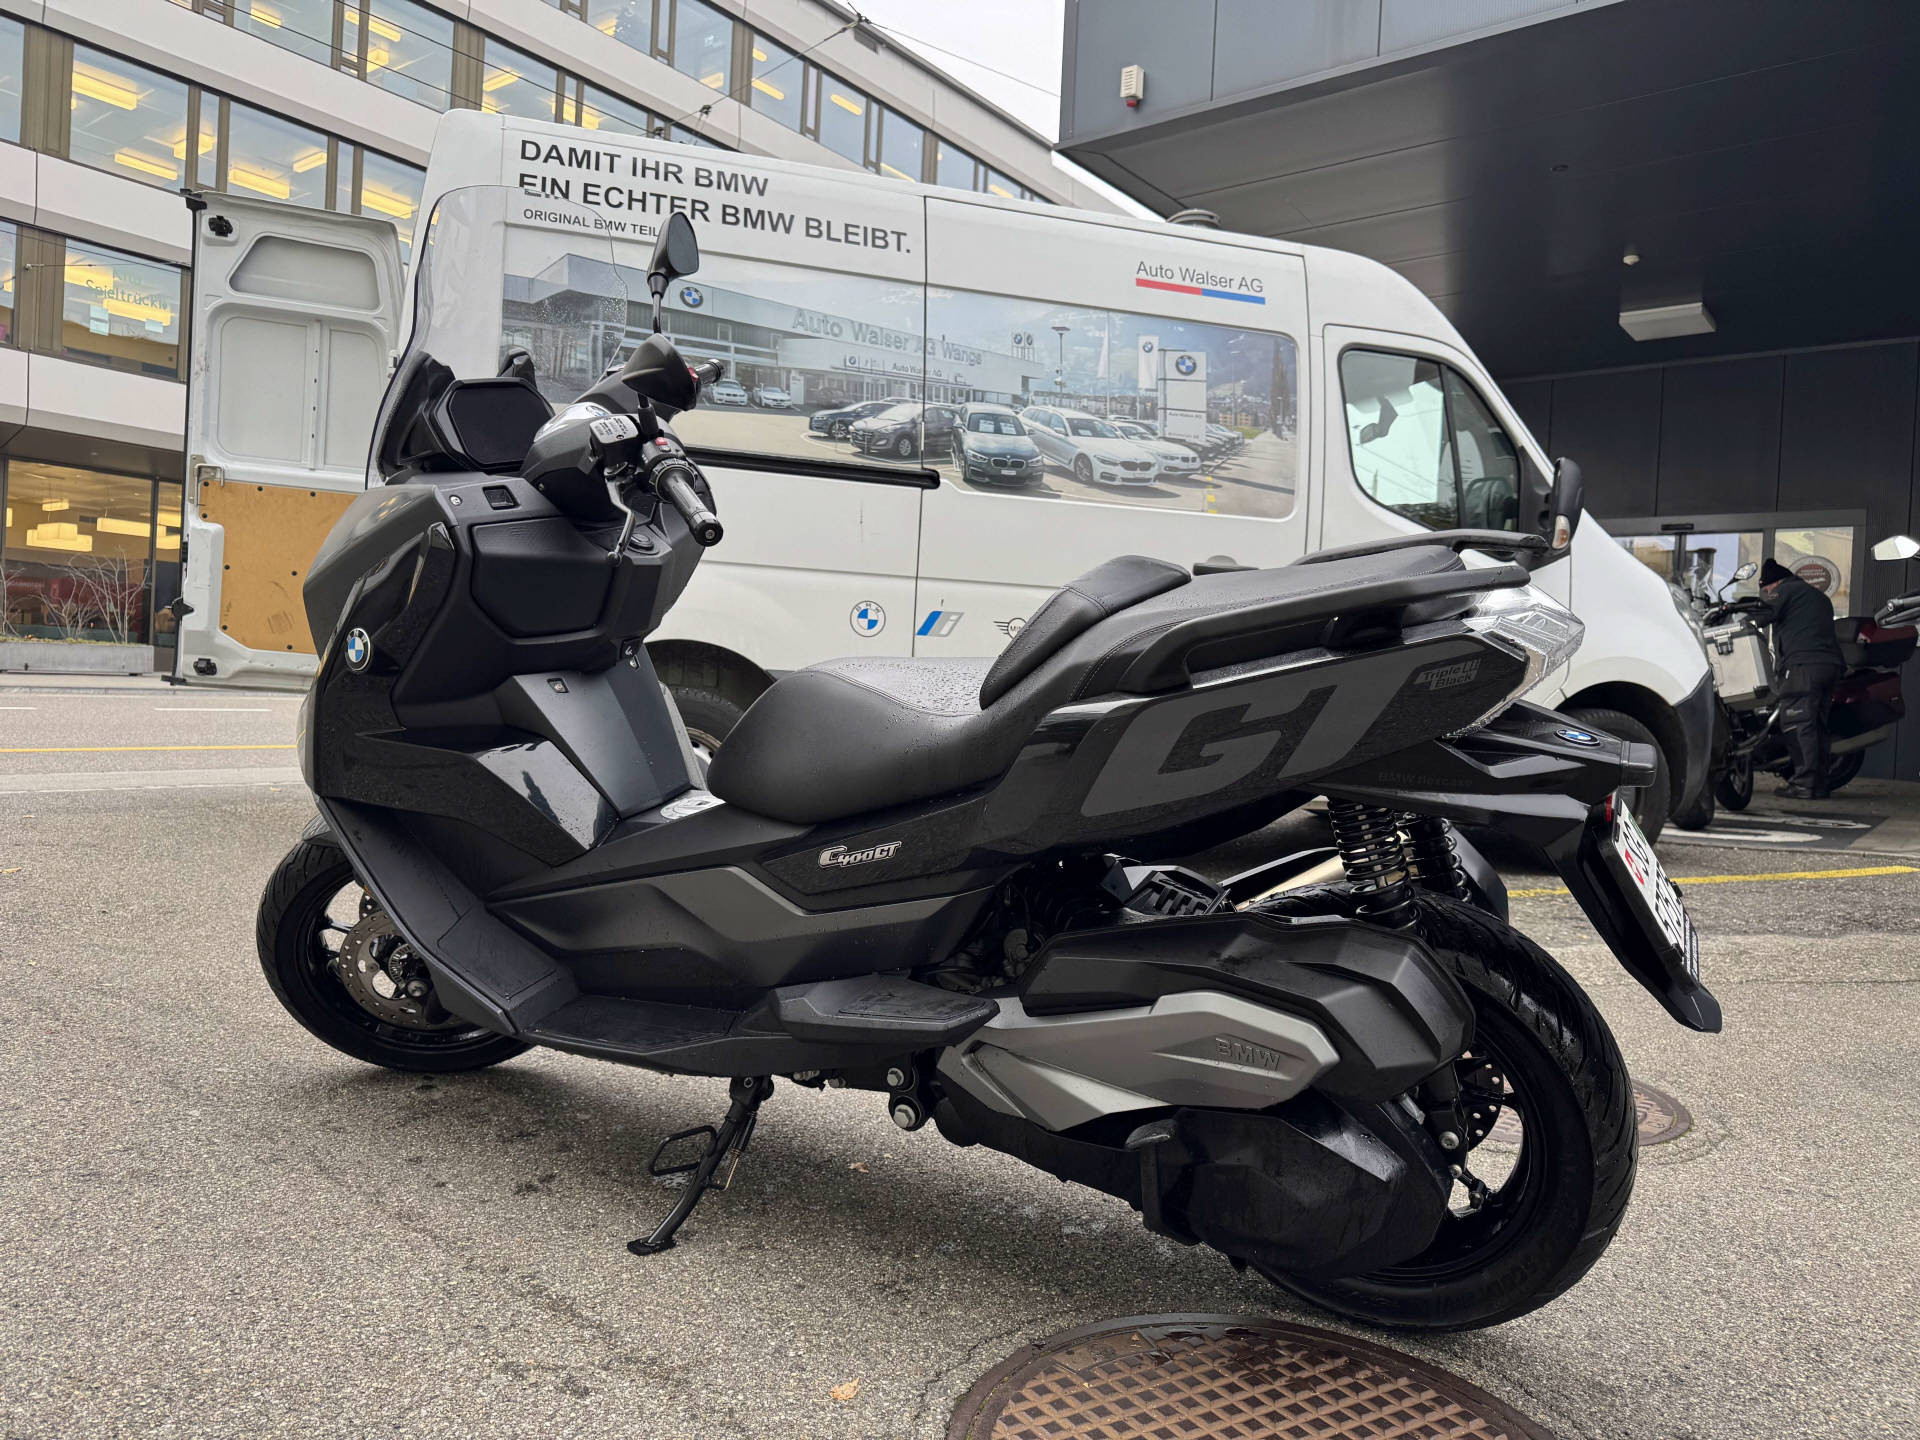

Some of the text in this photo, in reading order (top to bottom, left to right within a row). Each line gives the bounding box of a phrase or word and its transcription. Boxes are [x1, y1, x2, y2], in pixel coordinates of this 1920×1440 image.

[520, 139, 769, 197] DAMIT IHR BMW
[519, 173, 911, 253] EIN ECHTER BMW BLEIBT.
[523, 208, 659, 237] ORIGINAL BMW TEIL
[1136, 260, 1264, 293] Auto Walser AG
[792, 308, 843, 338] Auto
[850, 320, 909, 351] Walser
[1423, 664, 1461, 682] Triple
[1433, 673, 1474, 689] Black
[1080, 635, 1487, 817] GT
[1215, 1037, 1281, 1071] BMW
